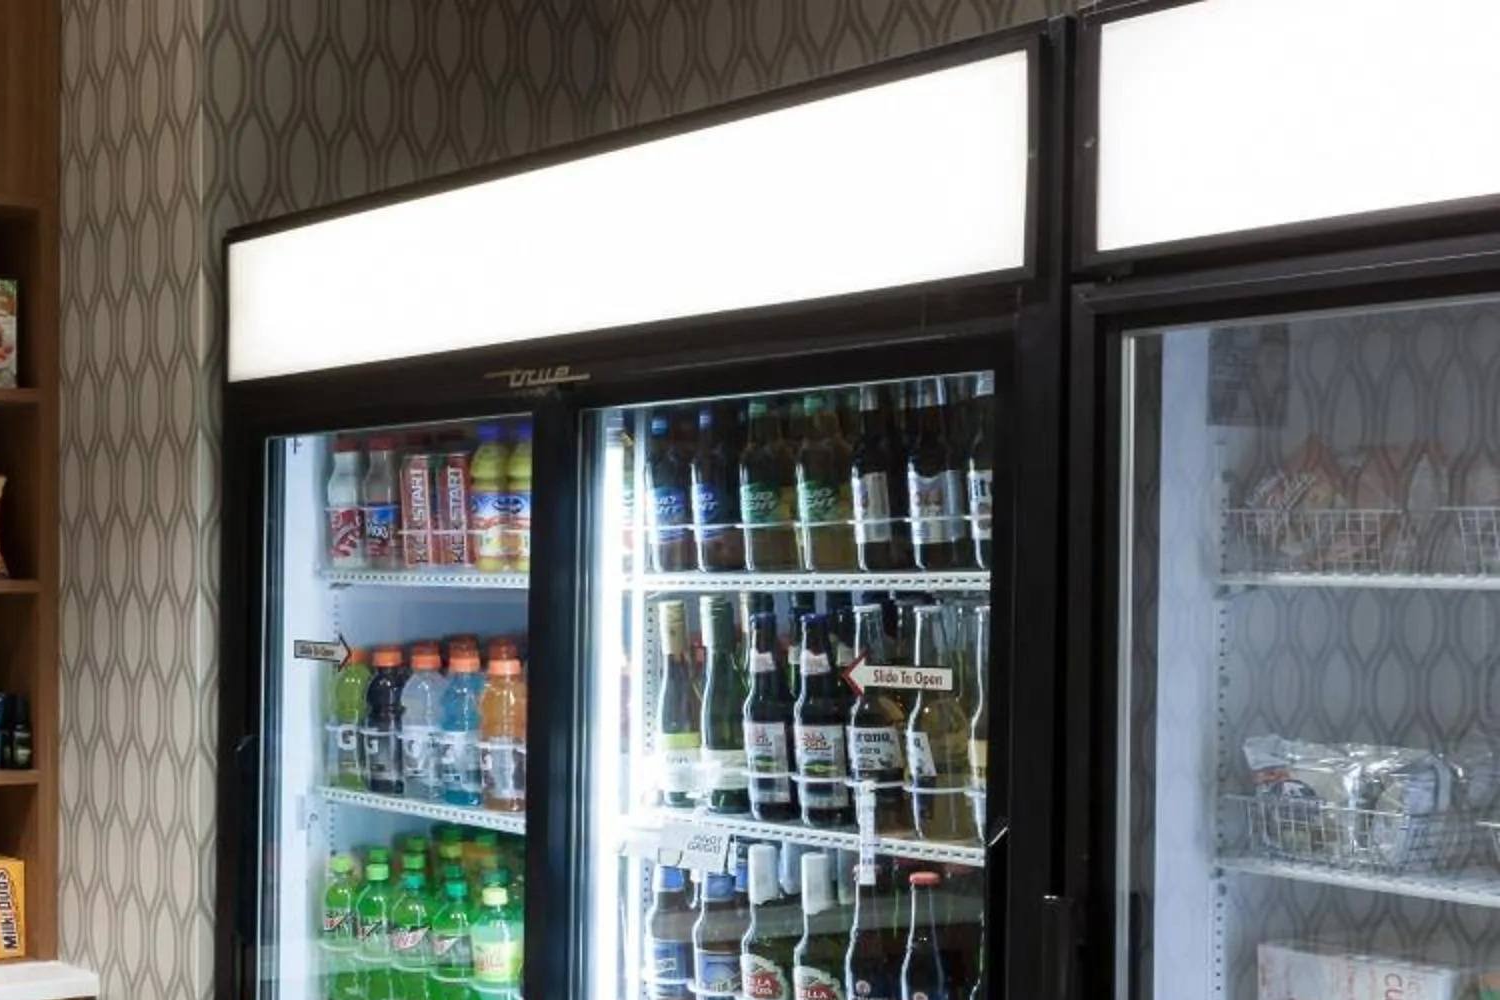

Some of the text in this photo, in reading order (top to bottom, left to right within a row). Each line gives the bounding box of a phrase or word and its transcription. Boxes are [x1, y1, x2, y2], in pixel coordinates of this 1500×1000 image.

[873, 669, 943, 687] Slide To Open
[0, 917, 18, 950] Milk
